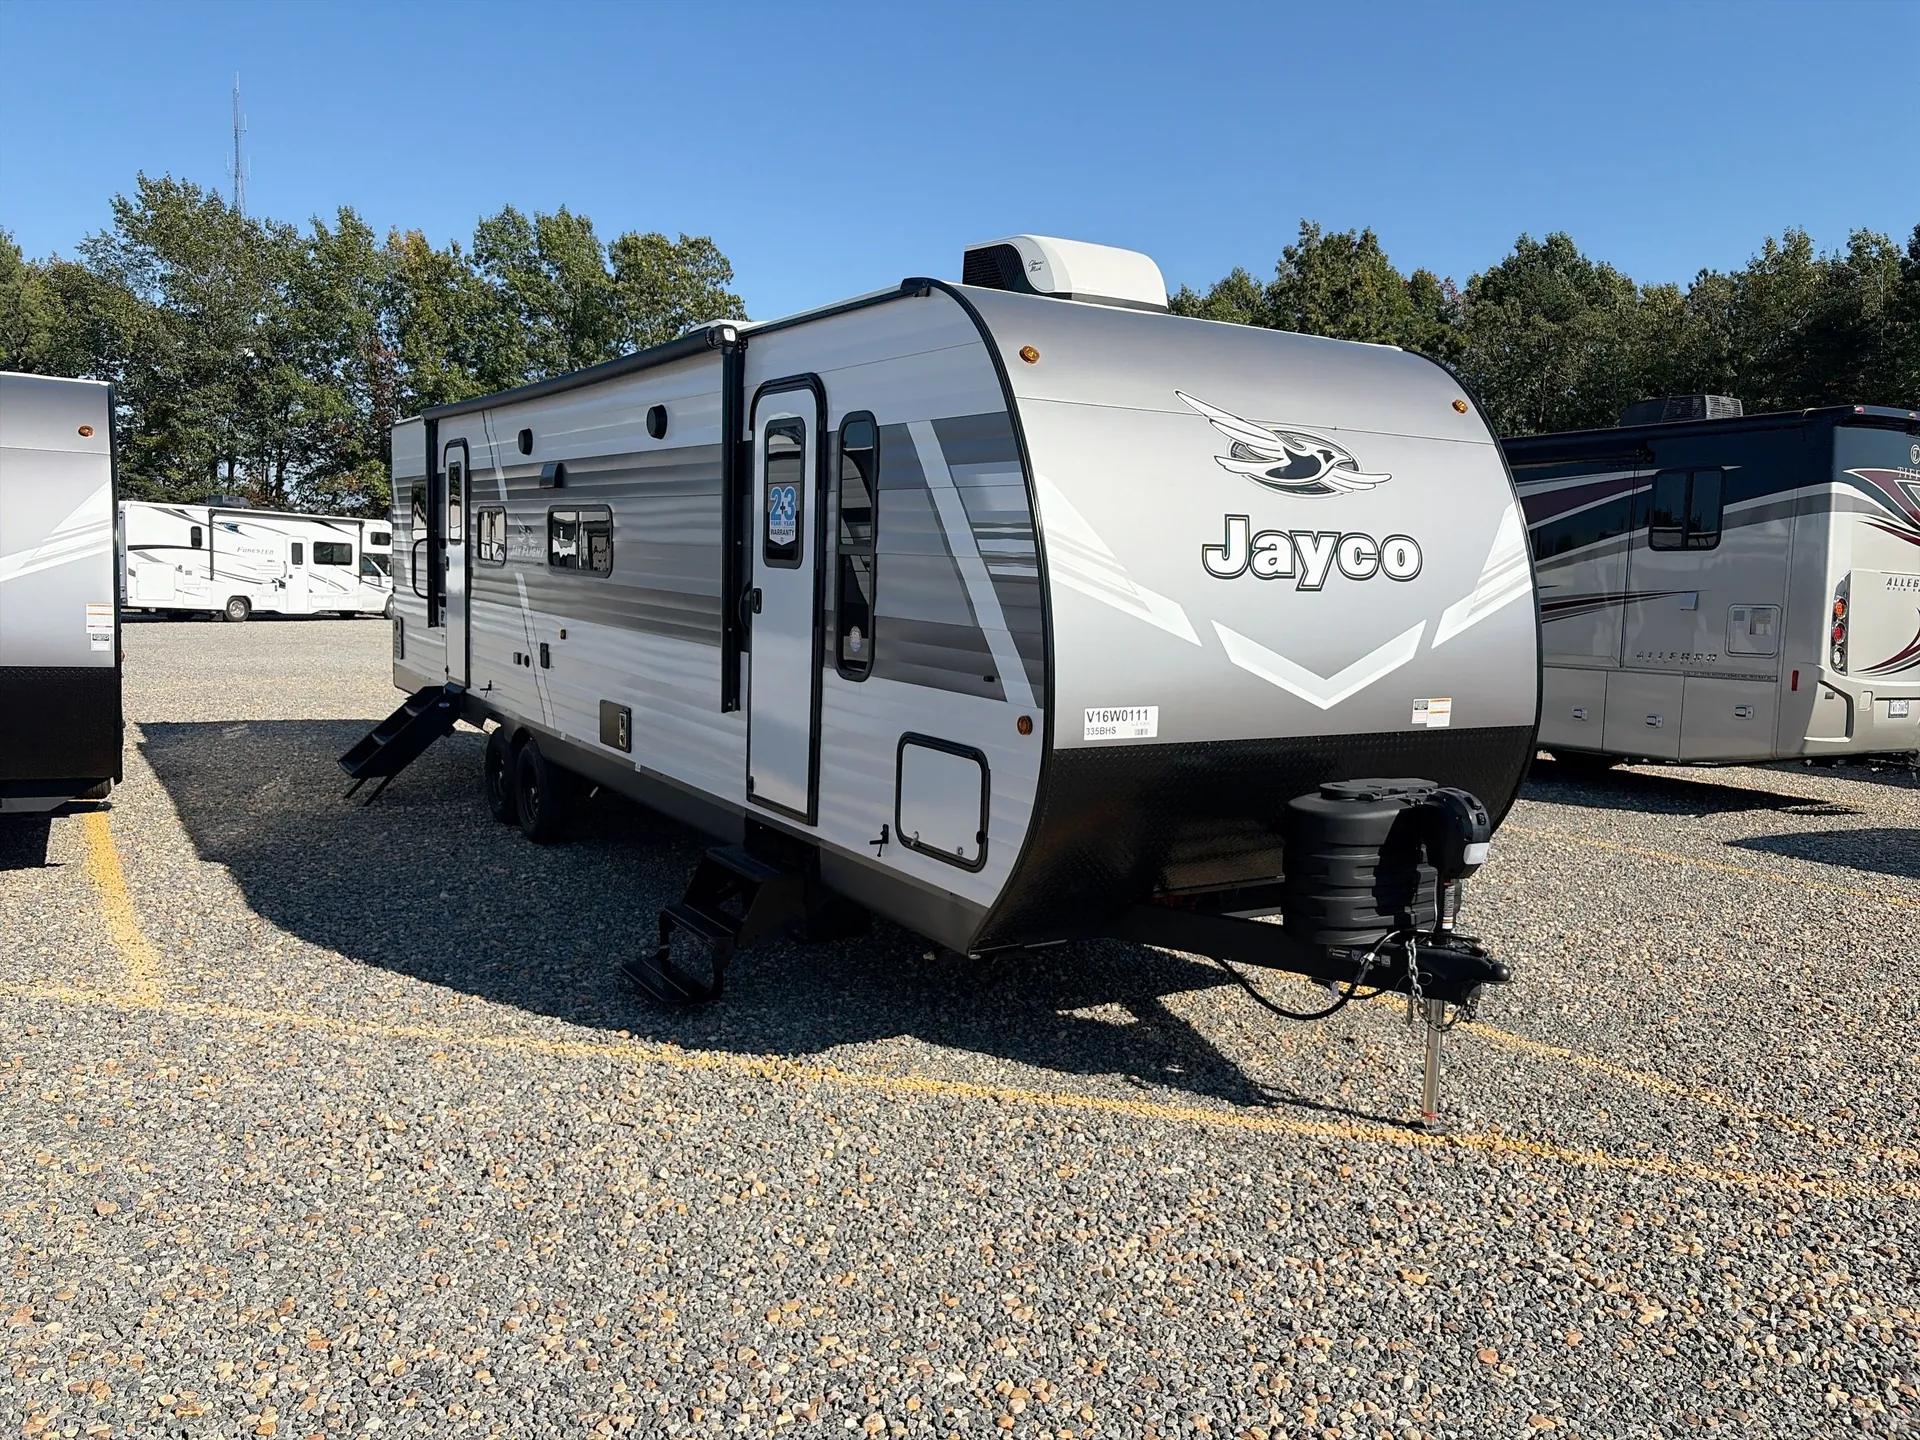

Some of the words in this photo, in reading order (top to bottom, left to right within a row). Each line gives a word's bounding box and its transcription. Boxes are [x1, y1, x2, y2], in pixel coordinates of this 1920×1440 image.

[1202, 513, 1423, 592] Jayco
[1086, 708, 1149, 723] V16W0111
[1085, 726, 1117, 736] 335BHS
